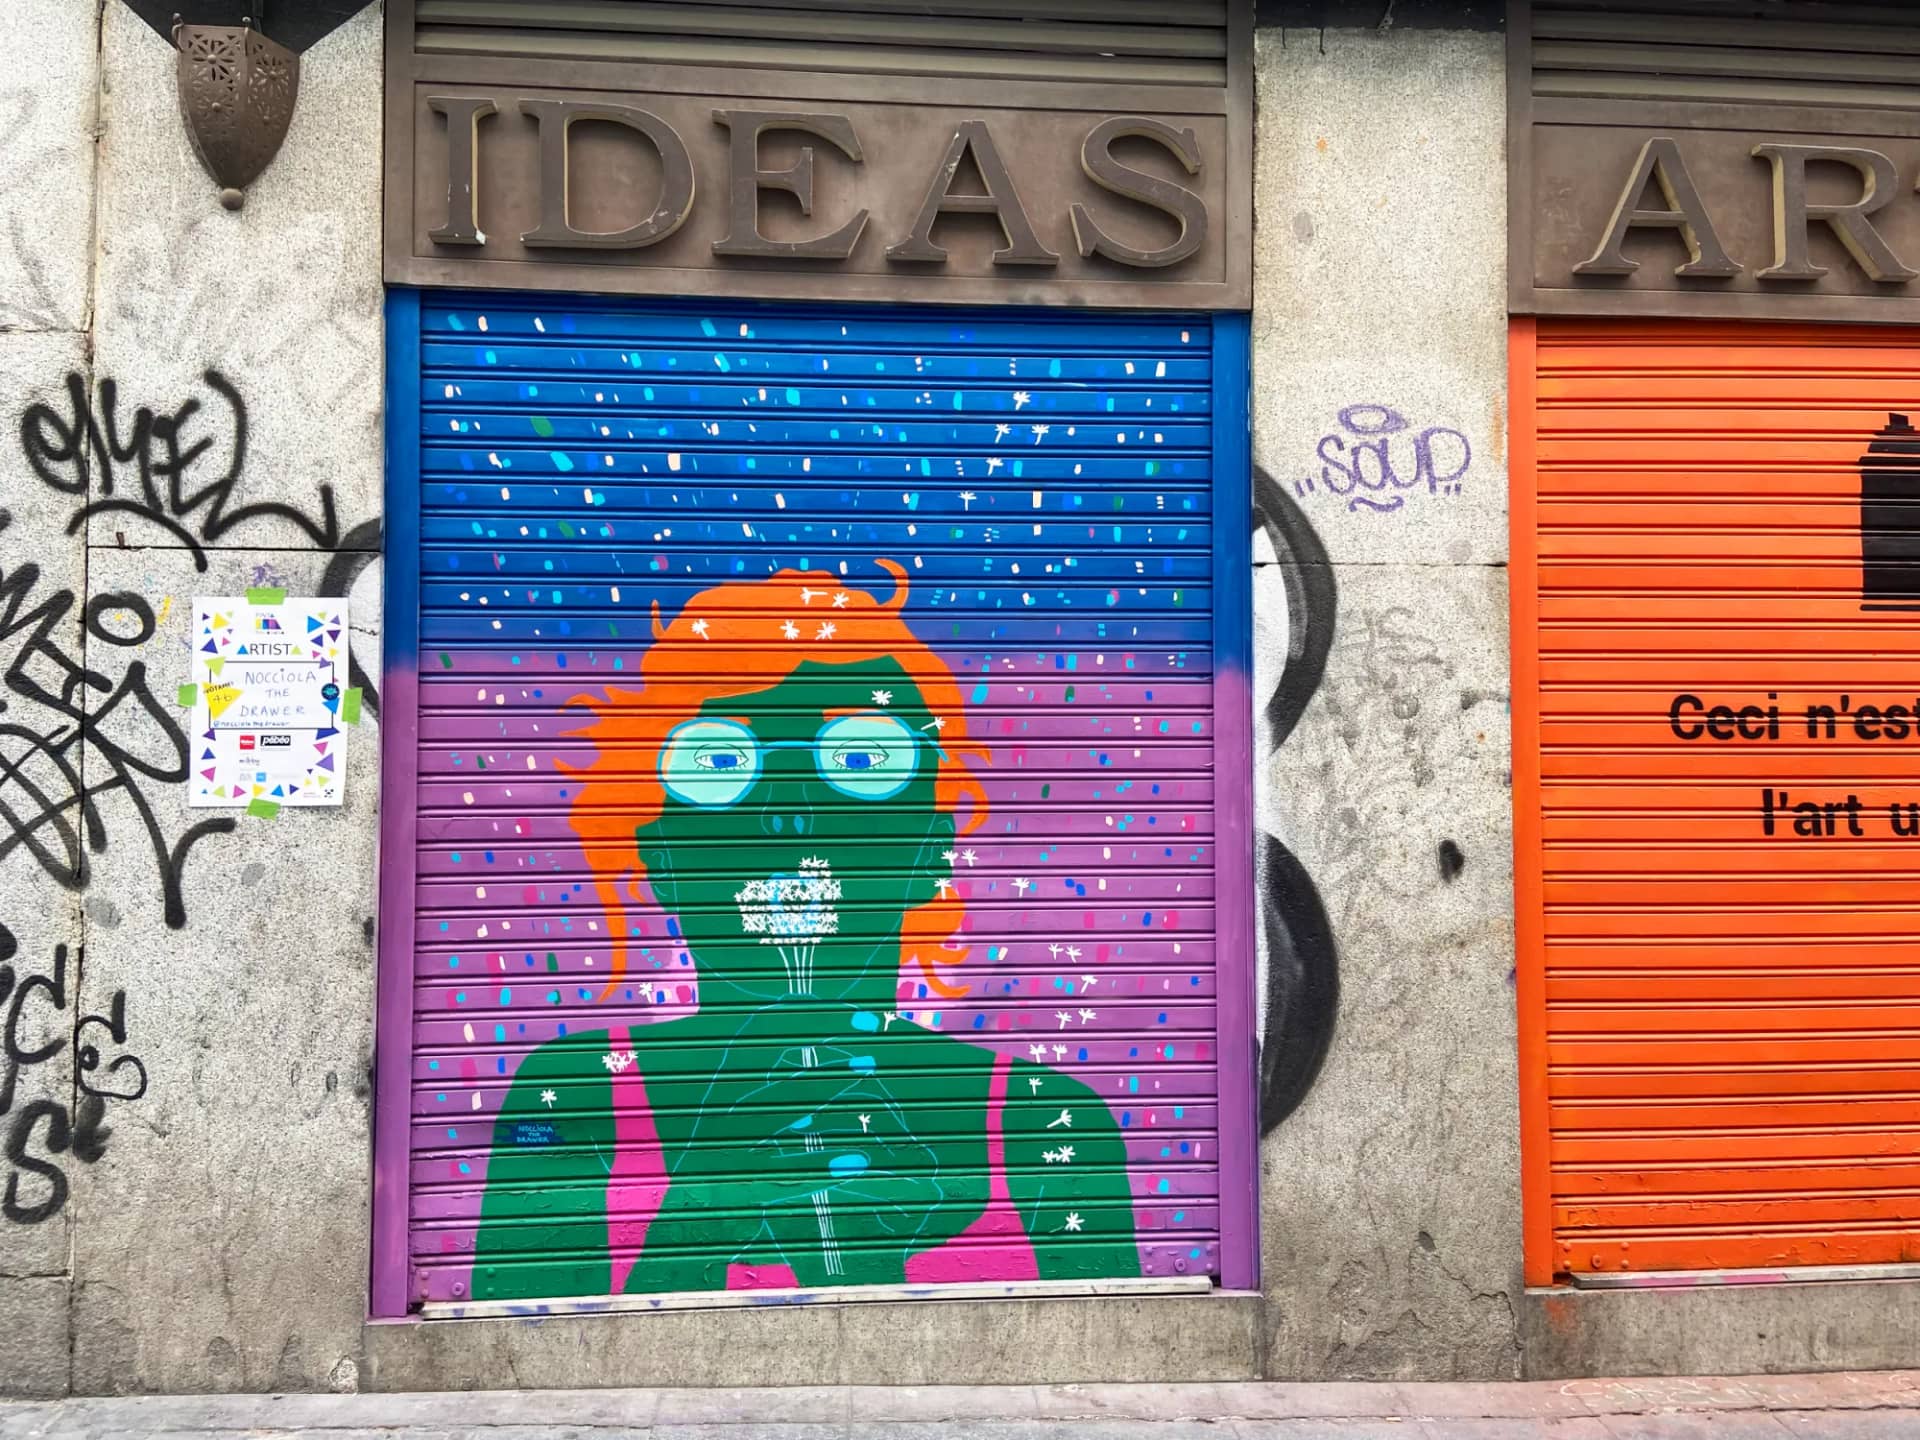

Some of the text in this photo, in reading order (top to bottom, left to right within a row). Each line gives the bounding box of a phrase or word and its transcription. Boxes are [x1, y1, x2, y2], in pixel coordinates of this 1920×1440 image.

[427, 95, 1208, 268] IDEAS
[1572, 137, 1920, 282] AR
[239, 704, 306, 718] DRAWER
[265, 688, 289, 698] THE
[1669, 693, 1779, 740] Ceci
[1761, 788, 1864, 837] l'art
